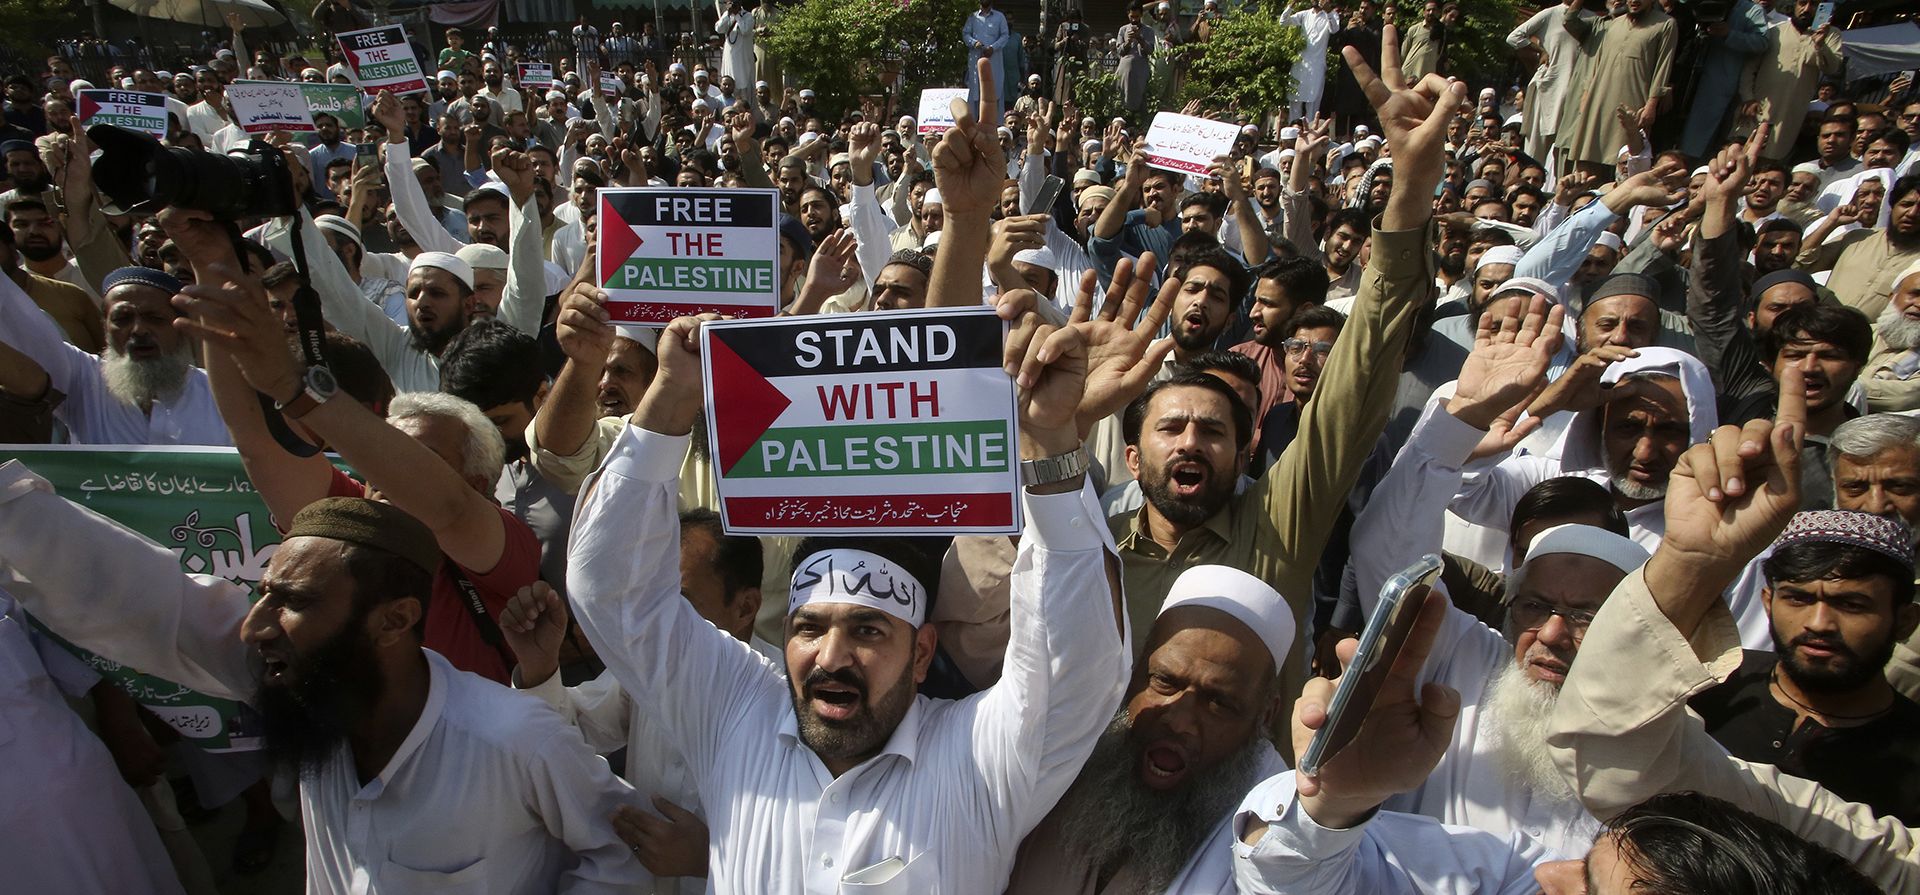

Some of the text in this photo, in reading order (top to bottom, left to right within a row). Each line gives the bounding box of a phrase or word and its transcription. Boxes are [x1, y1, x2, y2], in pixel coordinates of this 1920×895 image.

[355, 32, 388, 47] FREE
[366, 49, 390, 63] THE
[360, 61, 417, 79] PALESTINE
[109, 92, 147, 104] FREE
[113, 104, 142, 115] THE
[92, 116, 164, 129] PALESTINE
[655, 197, 733, 222] FREE
[666, 232, 724, 257] THE
[624, 265, 772, 290] PALESTINE
[308, 329, 323, 361] Nikon
[794, 324, 957, 369] STAND
[816, 380, 940, 422] WITH
[761, 432, 1006, 473] PALESTINE
[79, 478, 106, 500] ہے
[104, 473, 143, 492] تقاضا
[143, 472, 158, 492] کا
[157, 475, 198, 495] ایمان
[809, 500, 831, 524] خیبر
[832, 504, 852, 520] محاذ
[850, 500, 892, 525] شریعت
[468, 589, 486, 614] Nikon
